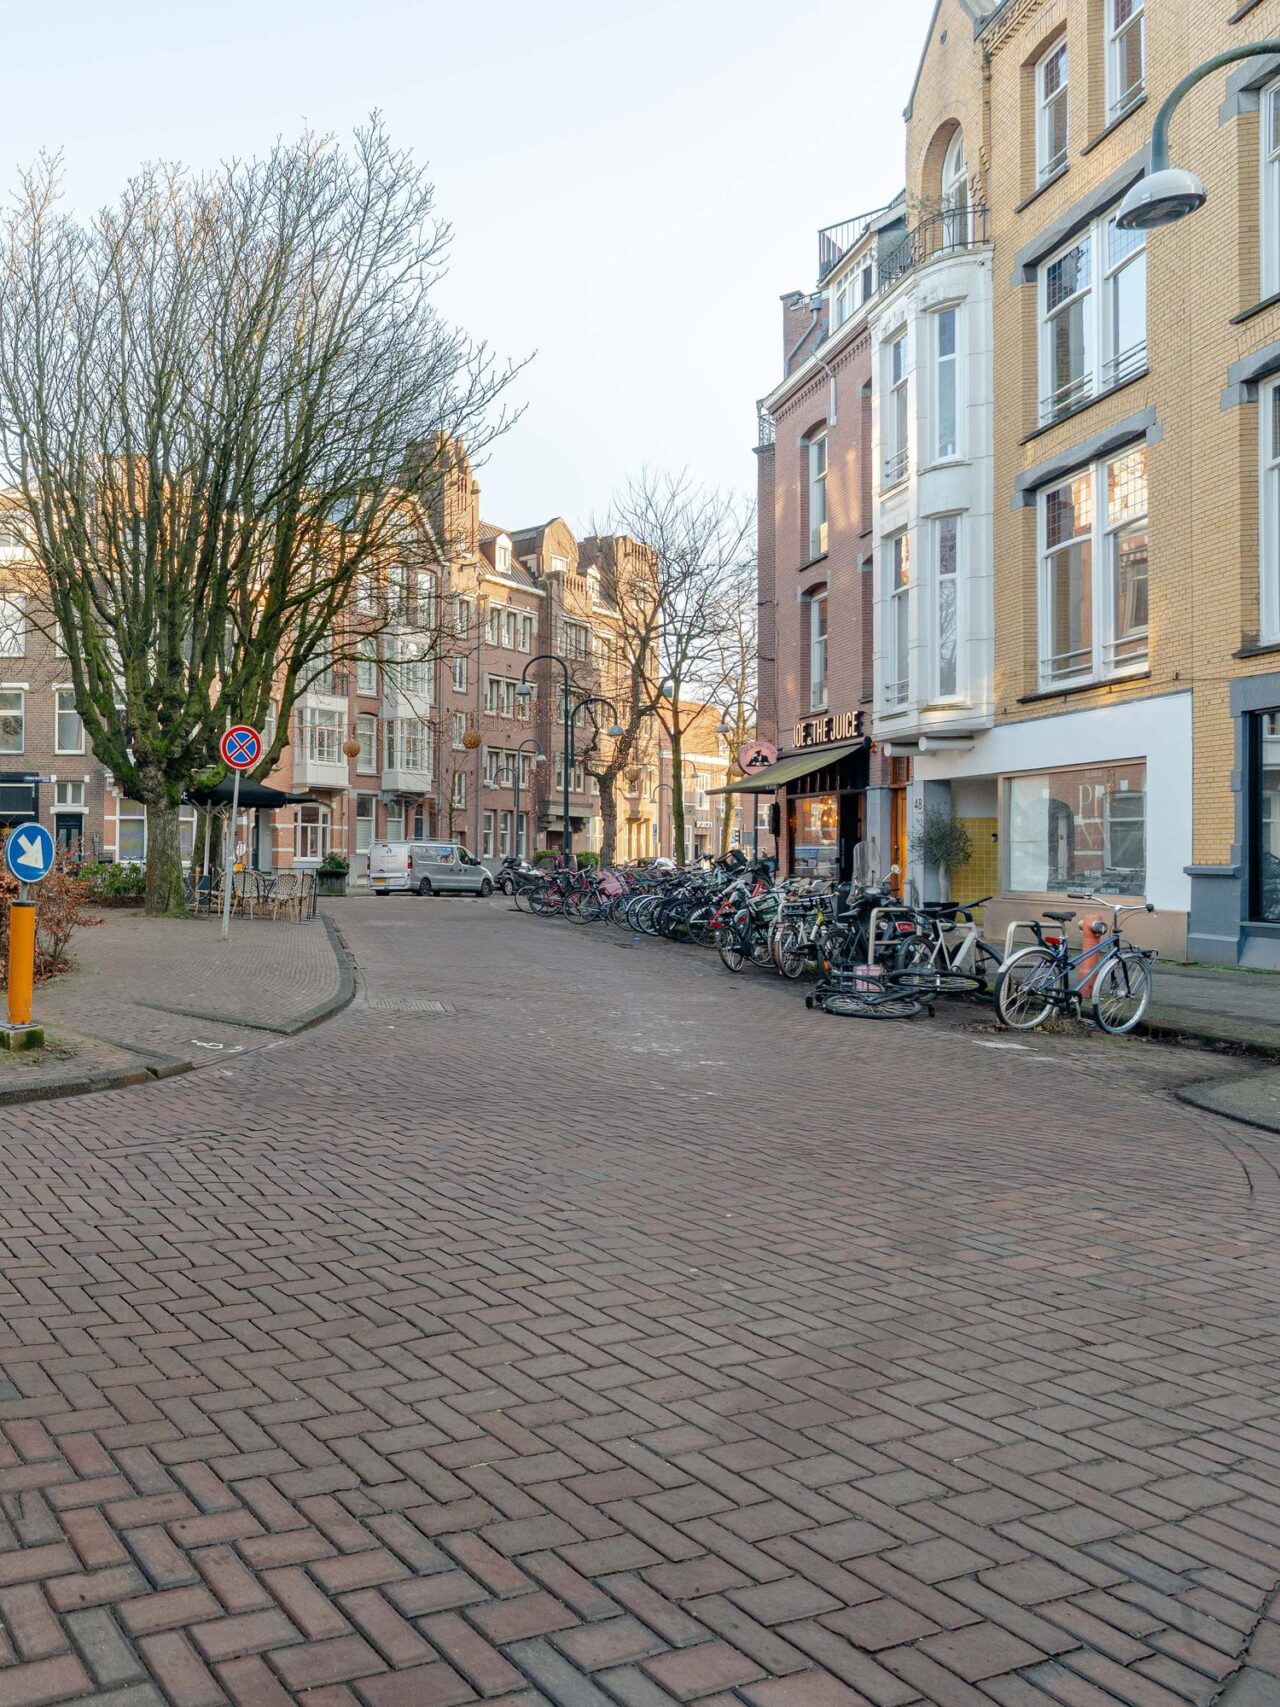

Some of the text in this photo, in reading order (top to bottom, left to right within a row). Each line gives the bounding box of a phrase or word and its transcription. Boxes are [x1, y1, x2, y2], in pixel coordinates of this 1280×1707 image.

[792, 711, 858, 747] JOE & THE JUICE
